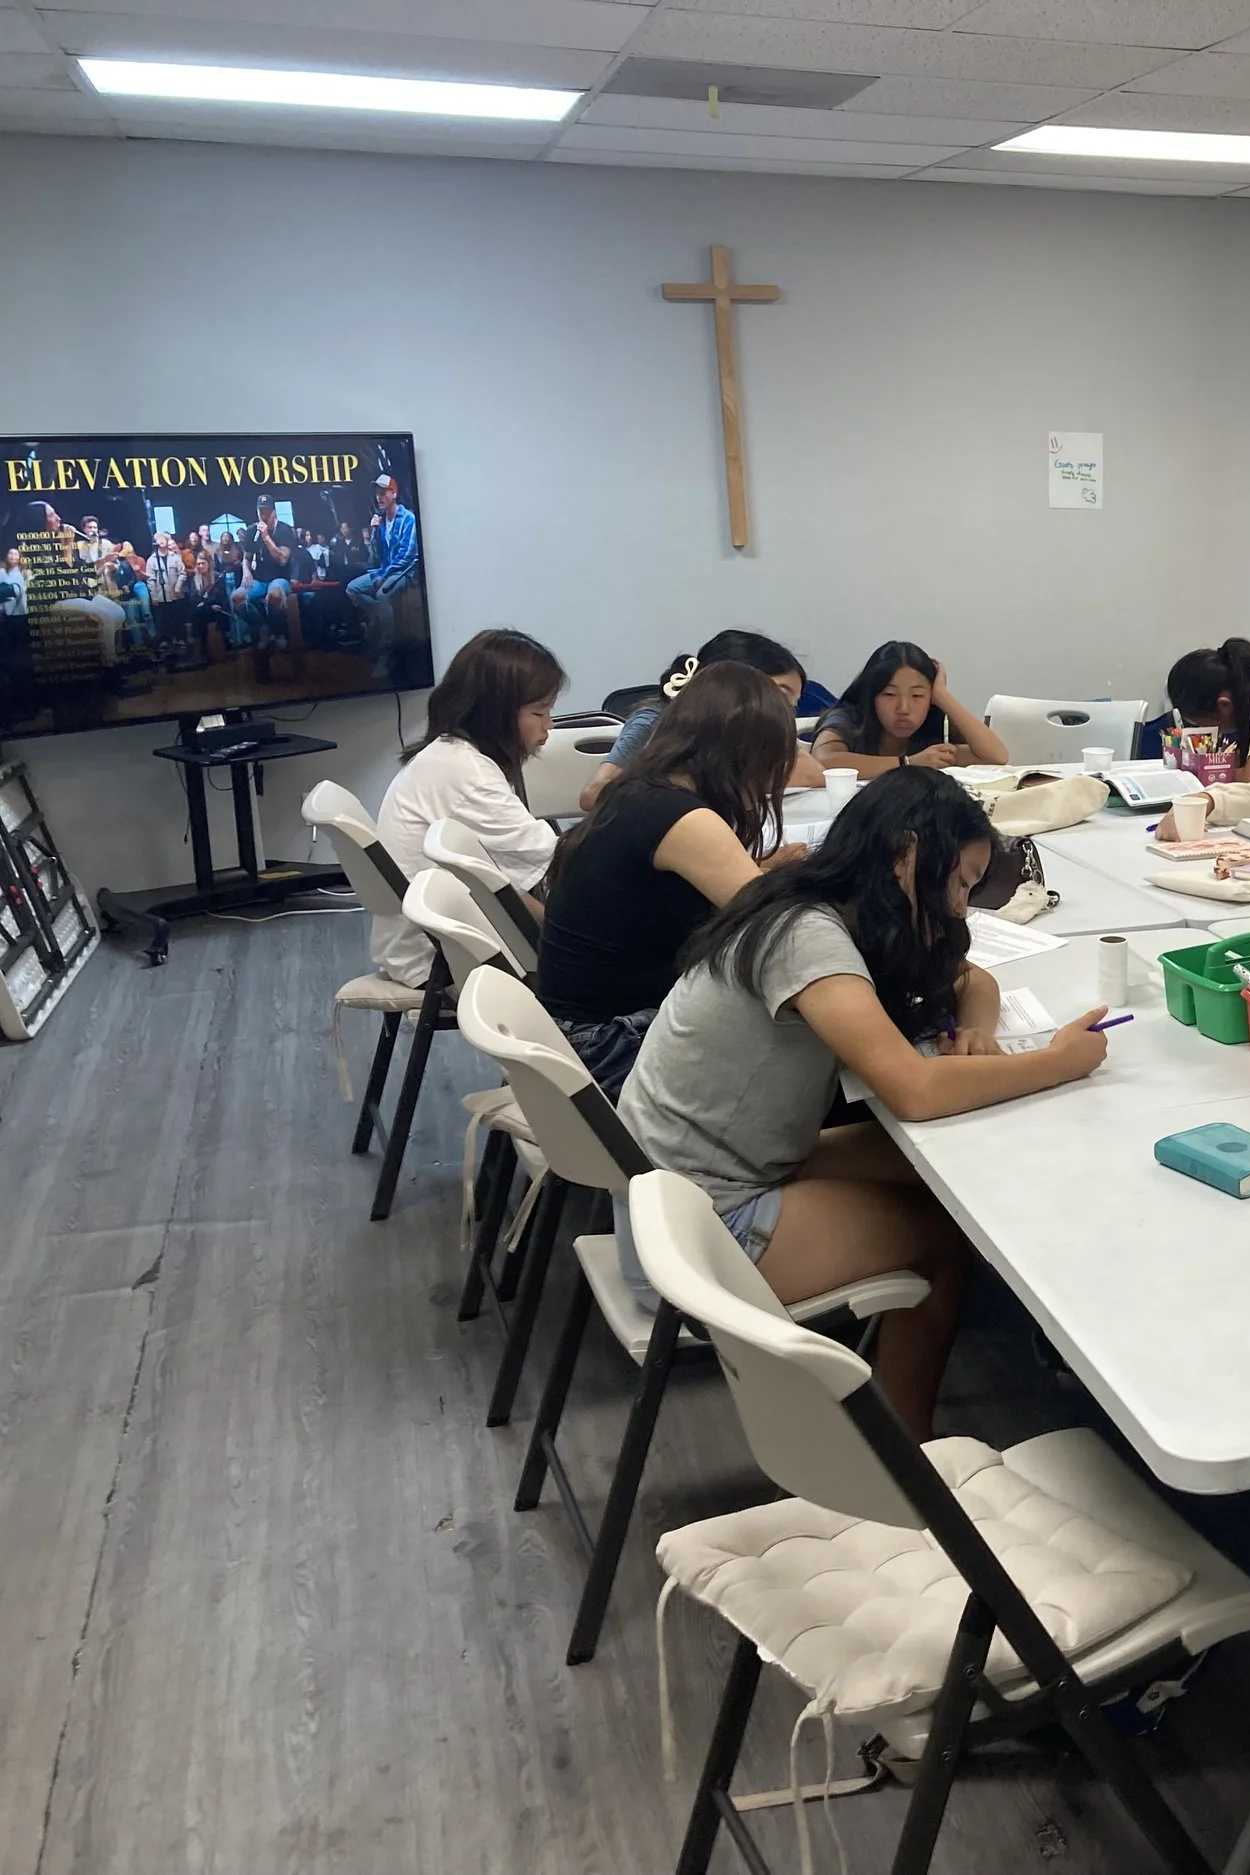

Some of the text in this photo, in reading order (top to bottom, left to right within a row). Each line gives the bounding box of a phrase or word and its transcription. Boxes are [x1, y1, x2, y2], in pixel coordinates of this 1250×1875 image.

[5, 454, 359, 492] ELEVATION WORSHIP
[1208, 755, 1228, 765] MILK
